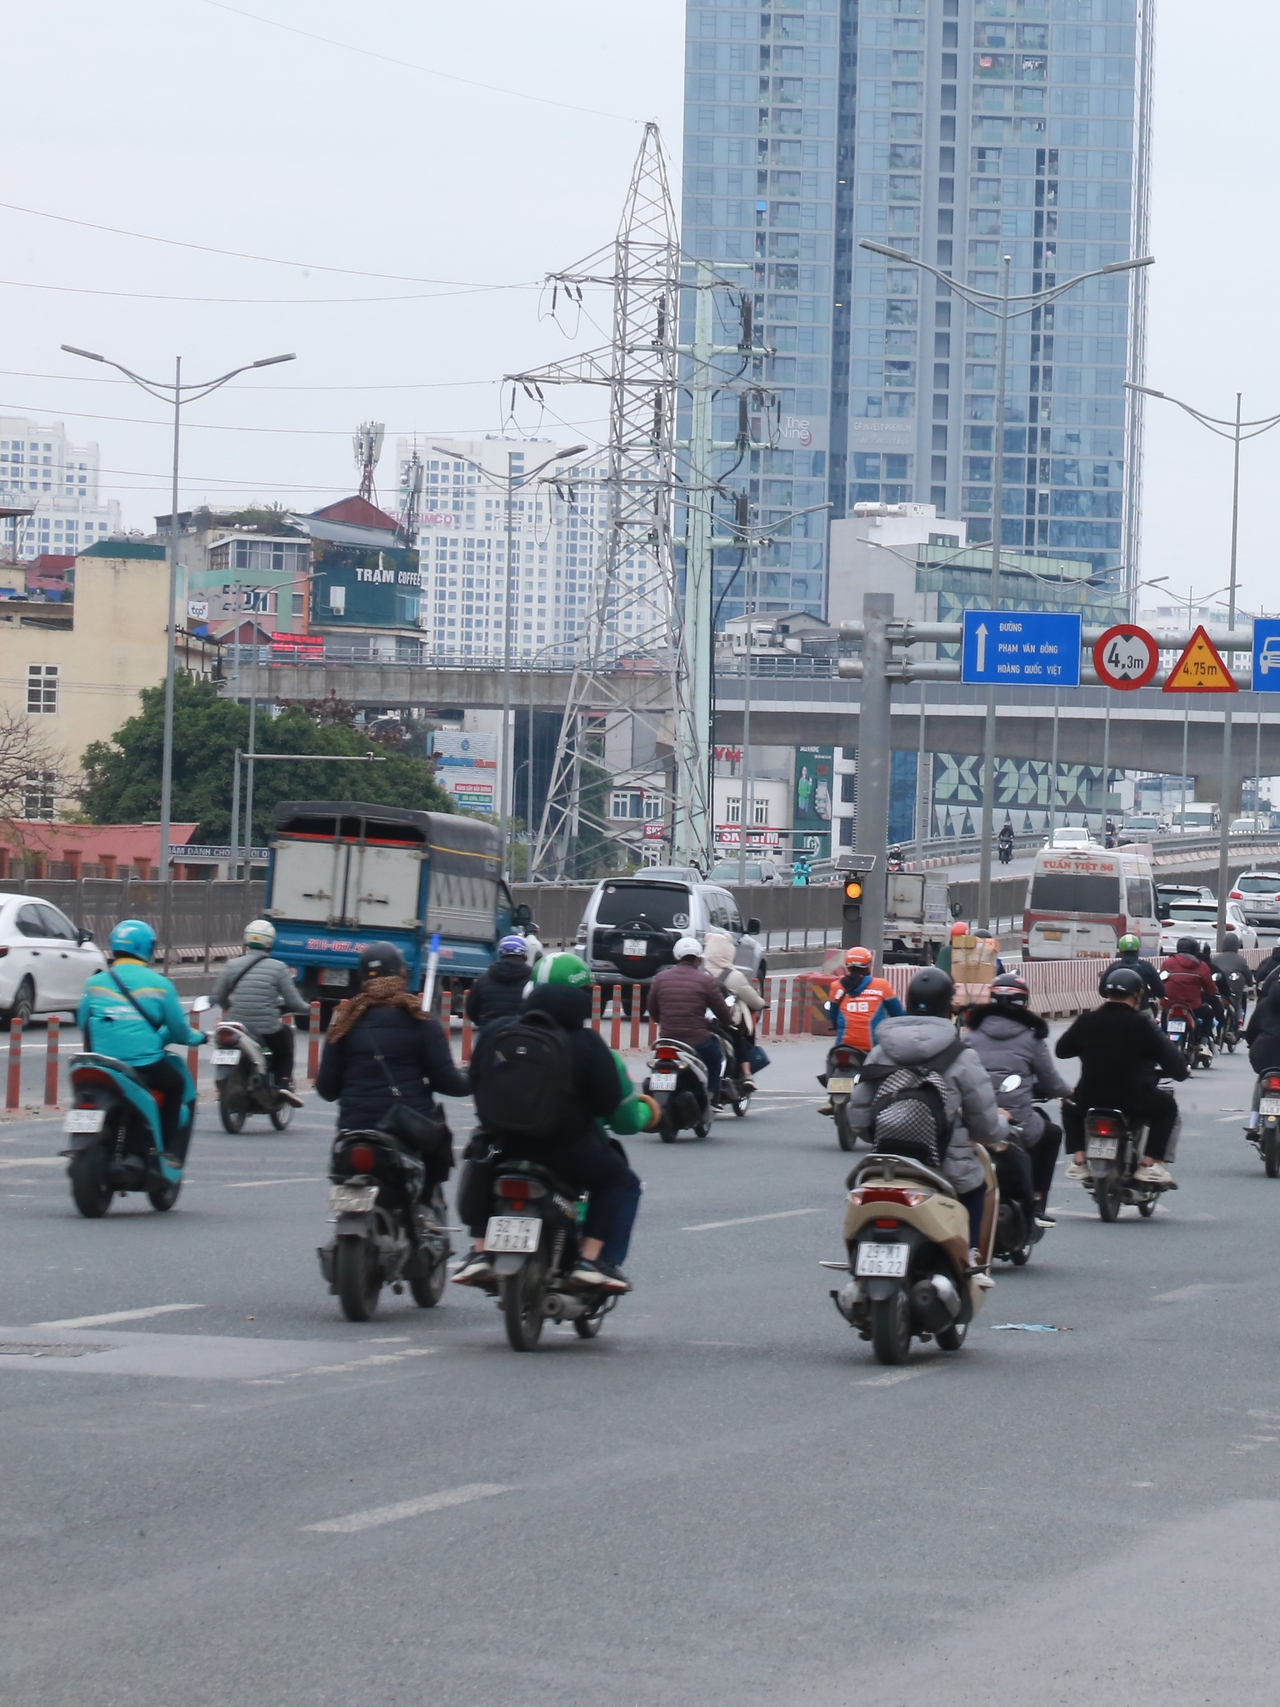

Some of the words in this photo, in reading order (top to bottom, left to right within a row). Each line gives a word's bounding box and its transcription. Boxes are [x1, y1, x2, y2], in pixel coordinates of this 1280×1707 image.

[786, 417, 809, 430] The
[779, 427, 810, 440] Nine
[356, 568, 395, 585] TRẠM
[398, 571, 422, 586] COFFEE
[999, 621, 1022, 633] ĐƯỜNG
[998, 643, 1018, 655] PHẠM
[1040, 641, 1059, 654] ĐỒNG
[1108, 642, 1144, 669] 4,3m
[997, 662, 1021, 674] HOÀNG
[1024, 662, 1043, 674] QUỐC
[1047, 664, 1062, 676] VIỆT
